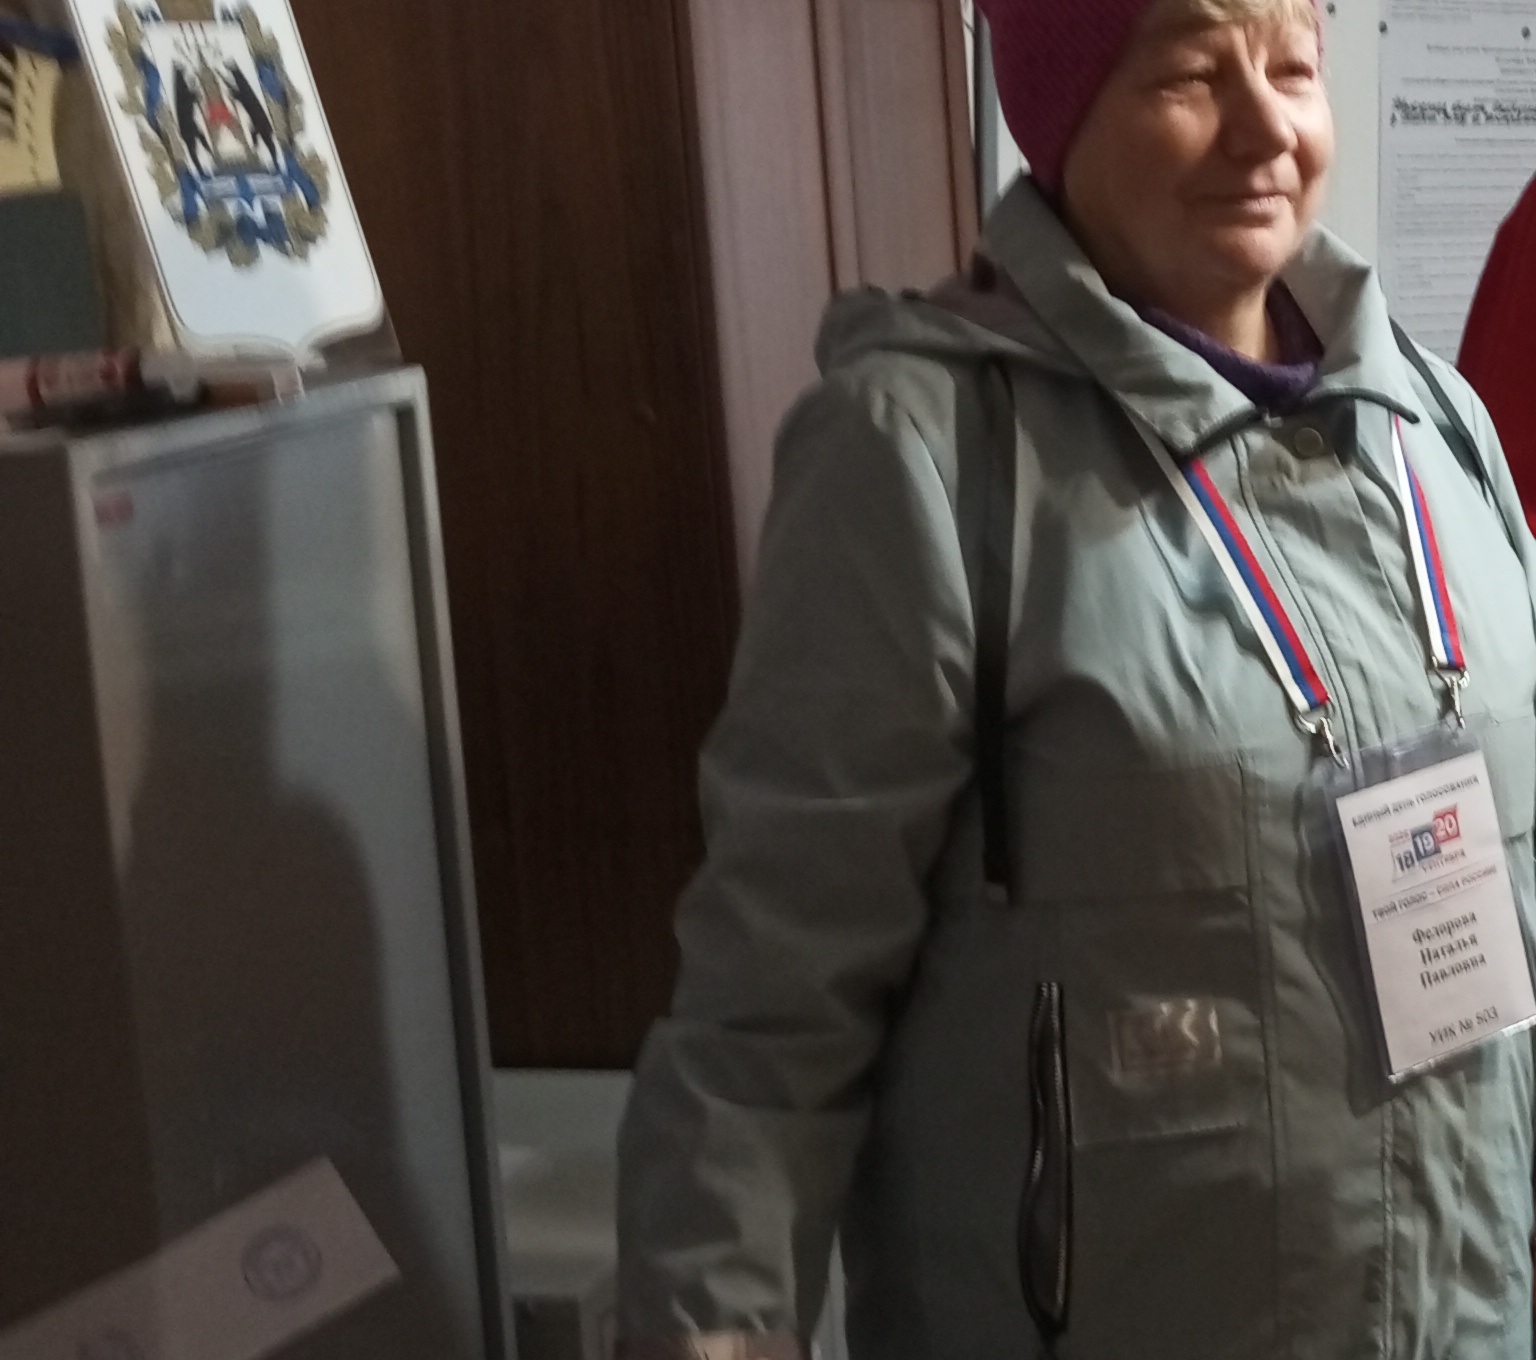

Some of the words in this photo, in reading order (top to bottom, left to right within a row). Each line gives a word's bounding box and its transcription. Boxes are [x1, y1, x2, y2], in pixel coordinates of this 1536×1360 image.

[1434, 813, 1459, 841] 20
[1414, 831, 1435, 857] 19
[1395, 849, 1415, 872] 18
[1420, 933, 1478, 967] Наталья
[1420, 953, 1487, 989] Павловна
[1429, 1023, 1457, 1043] УИК
